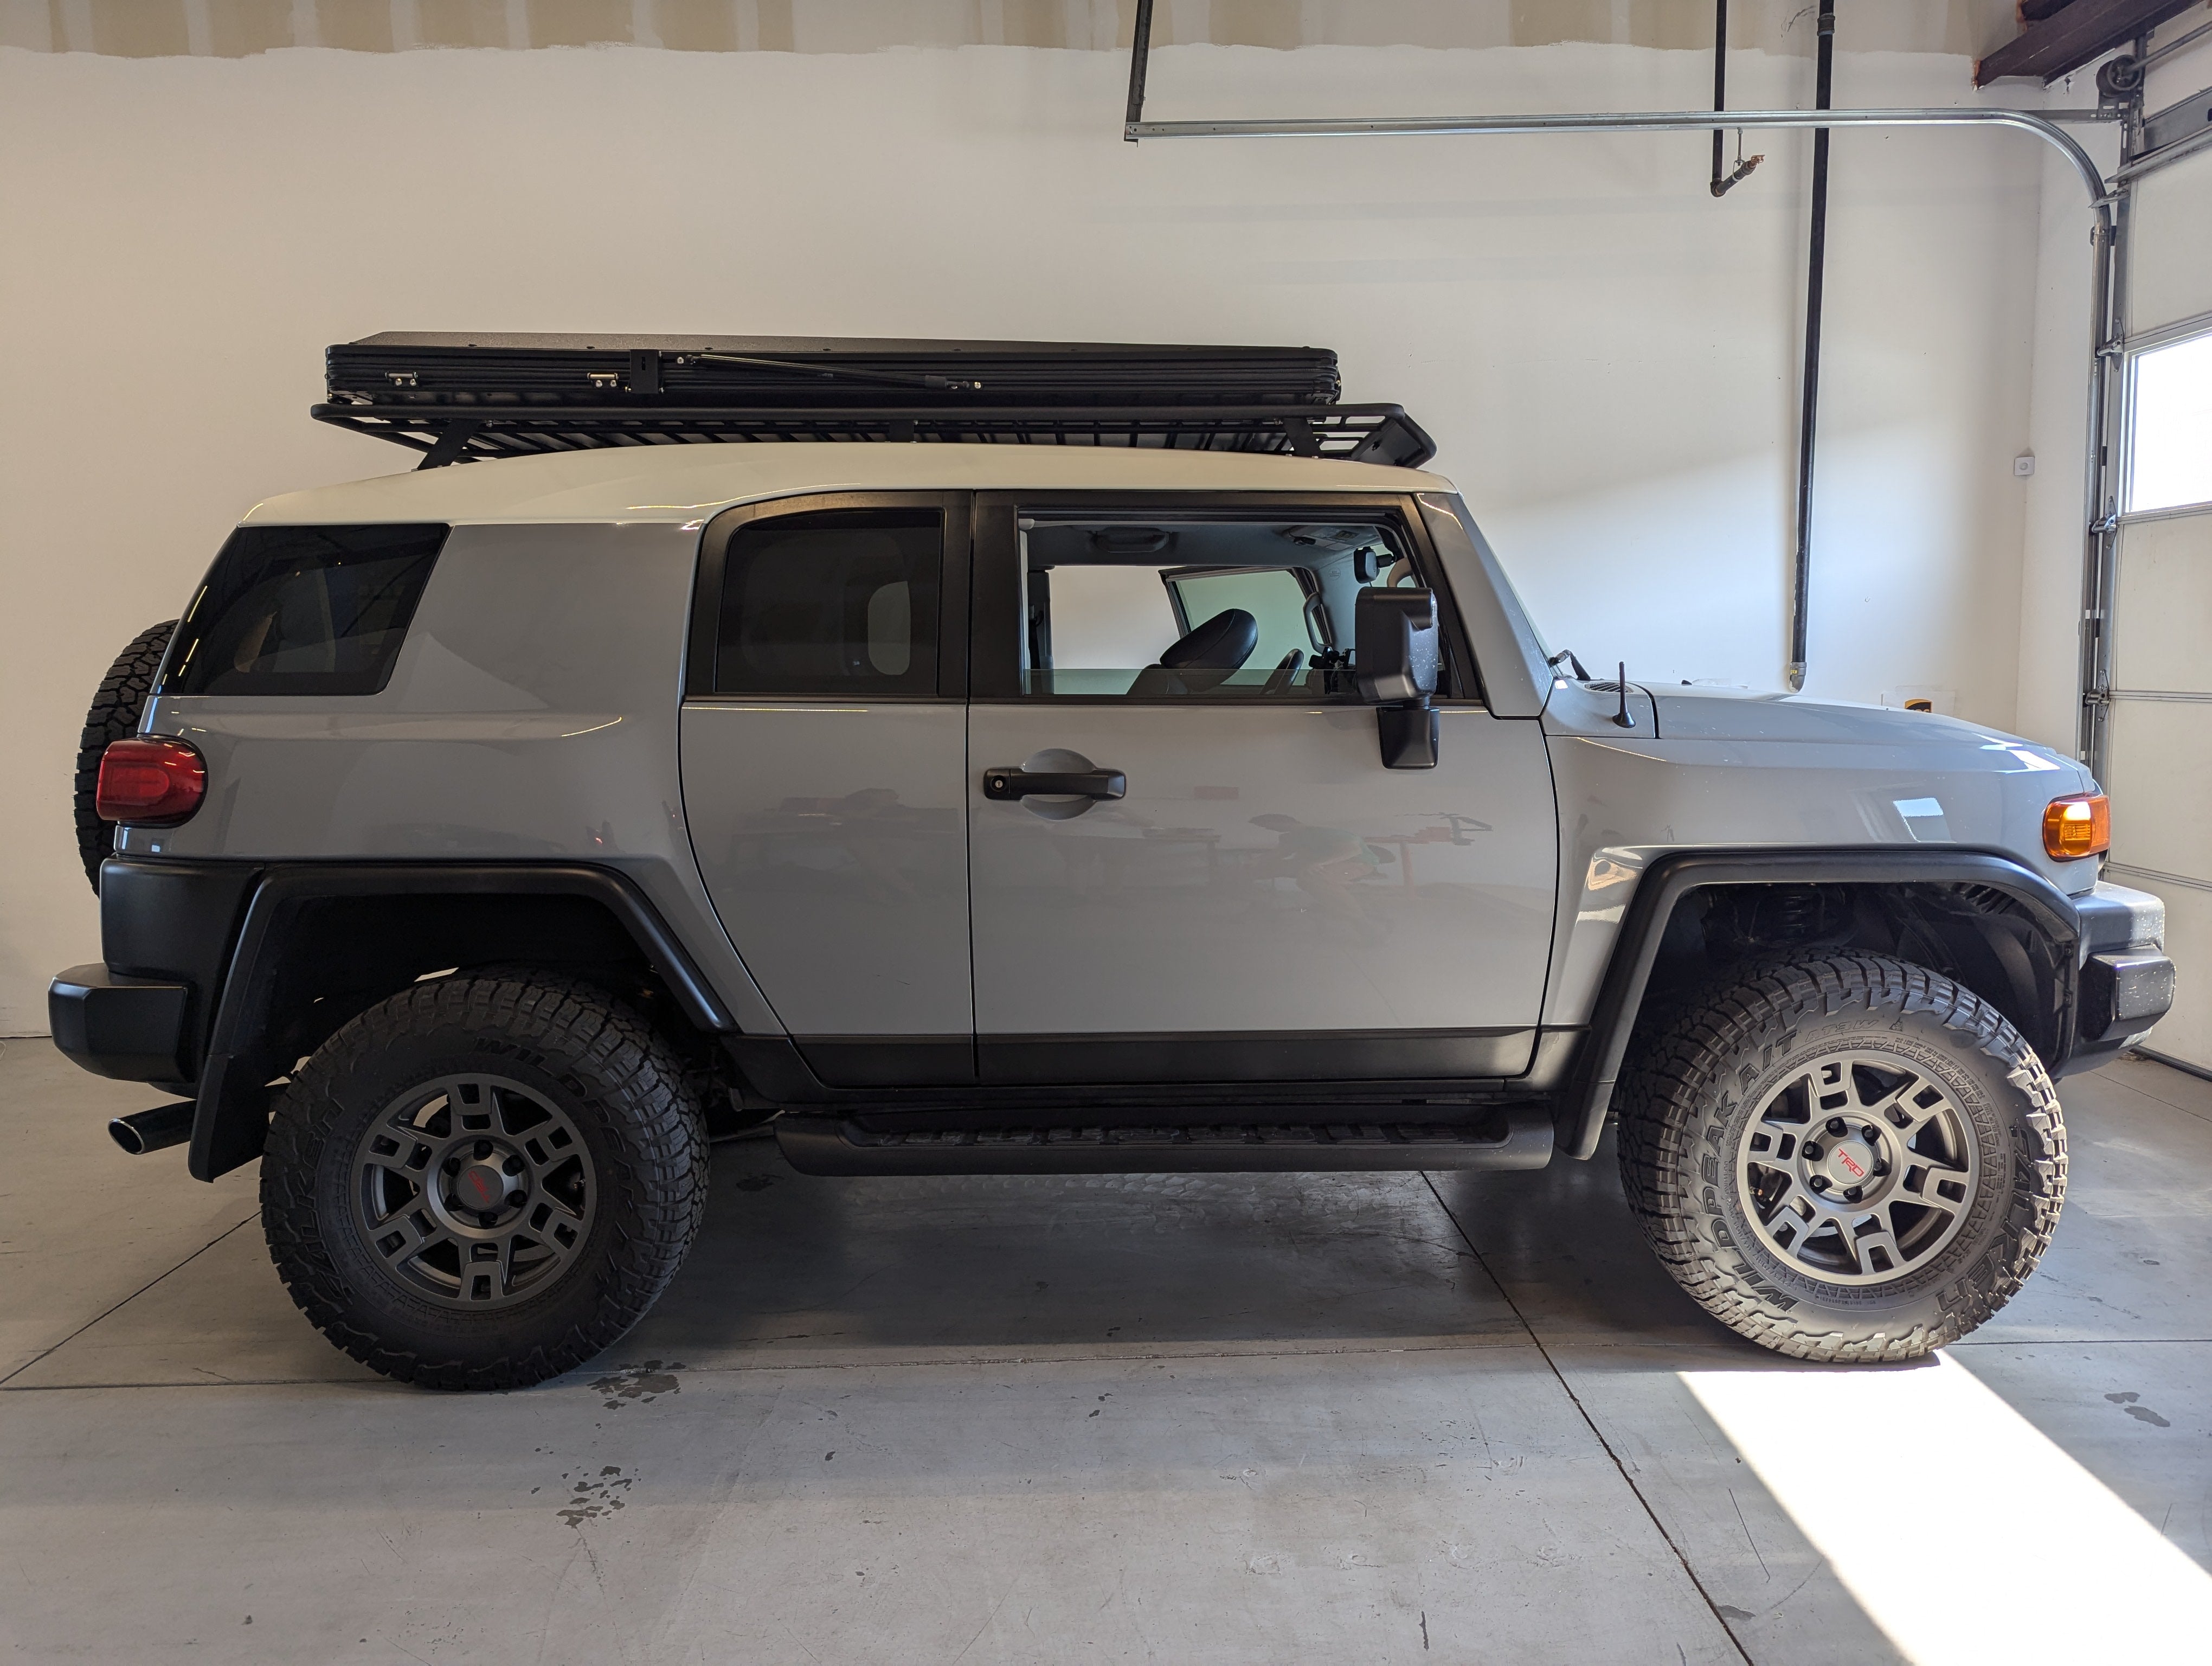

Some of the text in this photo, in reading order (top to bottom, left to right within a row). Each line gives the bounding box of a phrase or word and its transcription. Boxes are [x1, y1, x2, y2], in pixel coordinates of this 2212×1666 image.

[1702, 1091, 1799, 1312] WILDPEAK
[1805, 1020, 1879, 1042] AT3W
[1838, 1148, 1864, 1177] TRD
[467, 1171, 491, 1203] TRD
